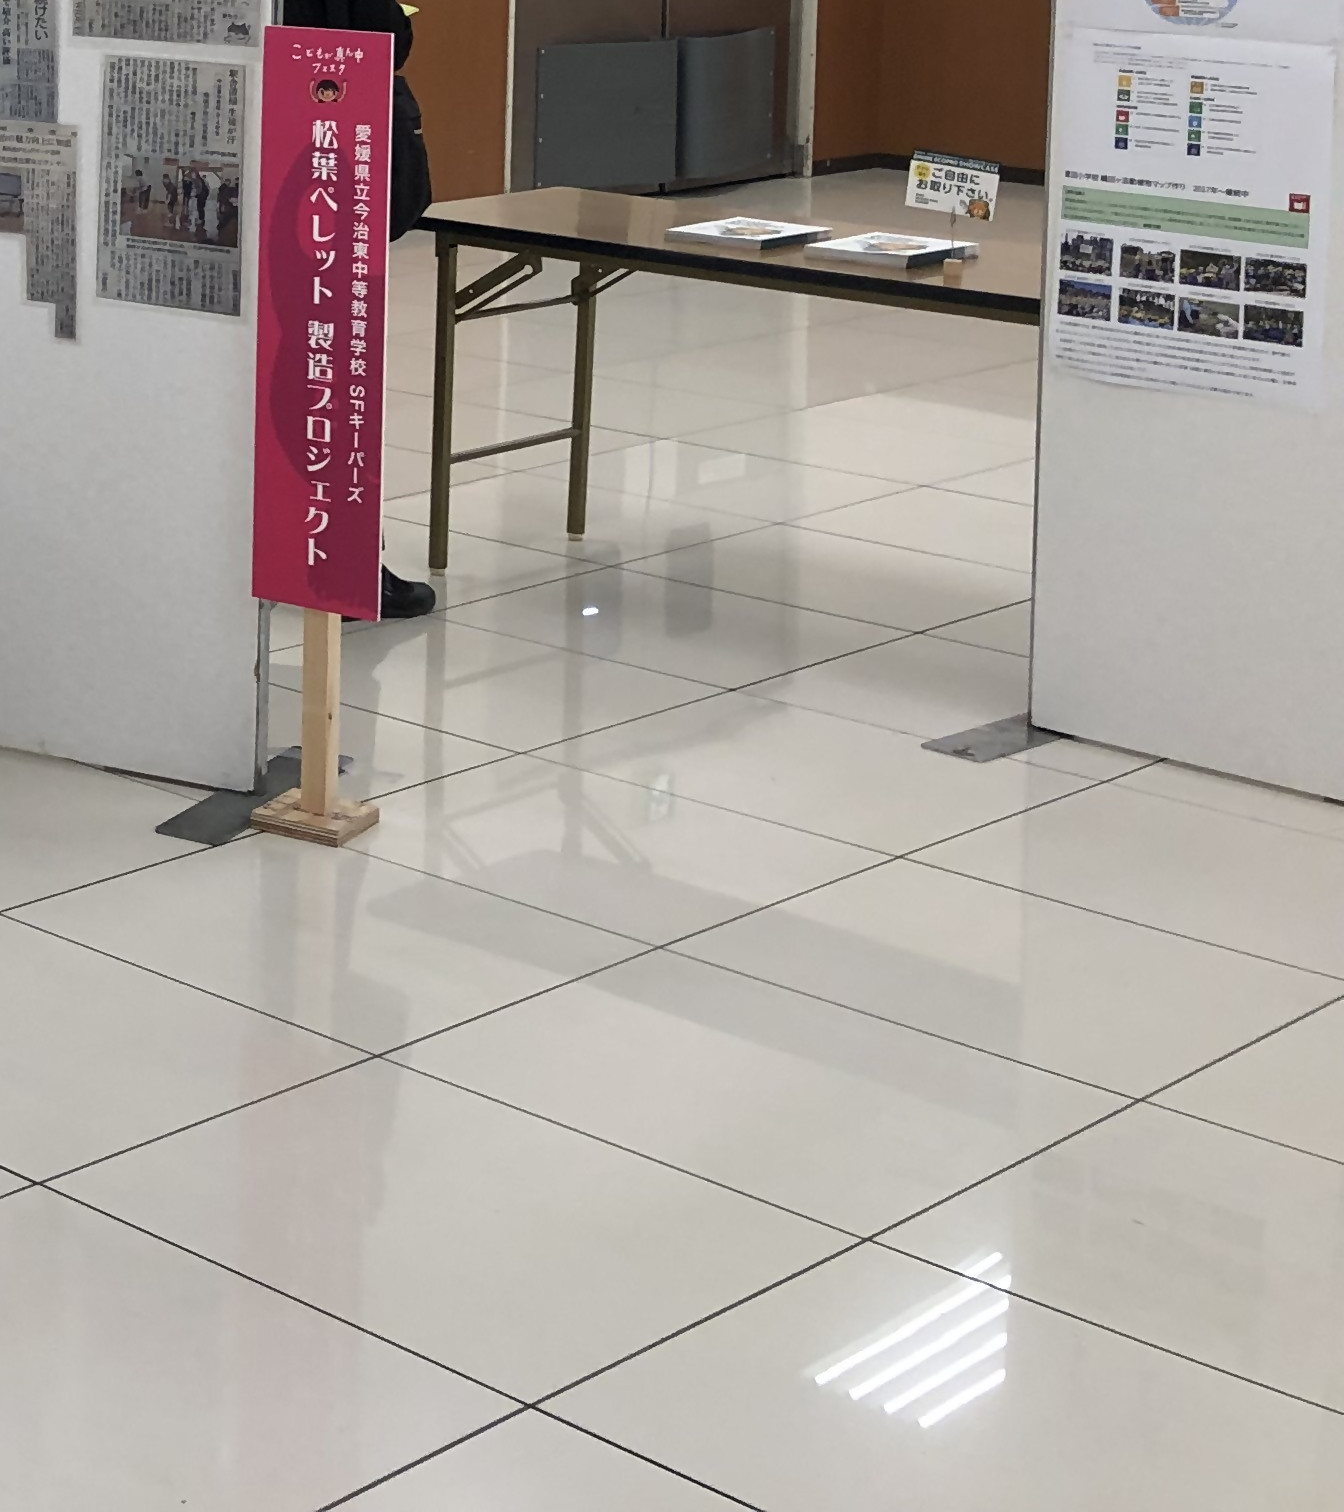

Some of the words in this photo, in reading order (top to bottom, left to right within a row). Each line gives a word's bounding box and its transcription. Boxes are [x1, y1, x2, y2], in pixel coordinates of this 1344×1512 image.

[309, 120, 338, 305] 松葉ペレット
[349, 124, 371, 377] 愛媛県立今治東中等教育学校
[916, 178, 994, 202] お取り下さい。
[932, 167, 980, 185] ご自由に
[304, 320, 334, 566] 製造プロジェクト
